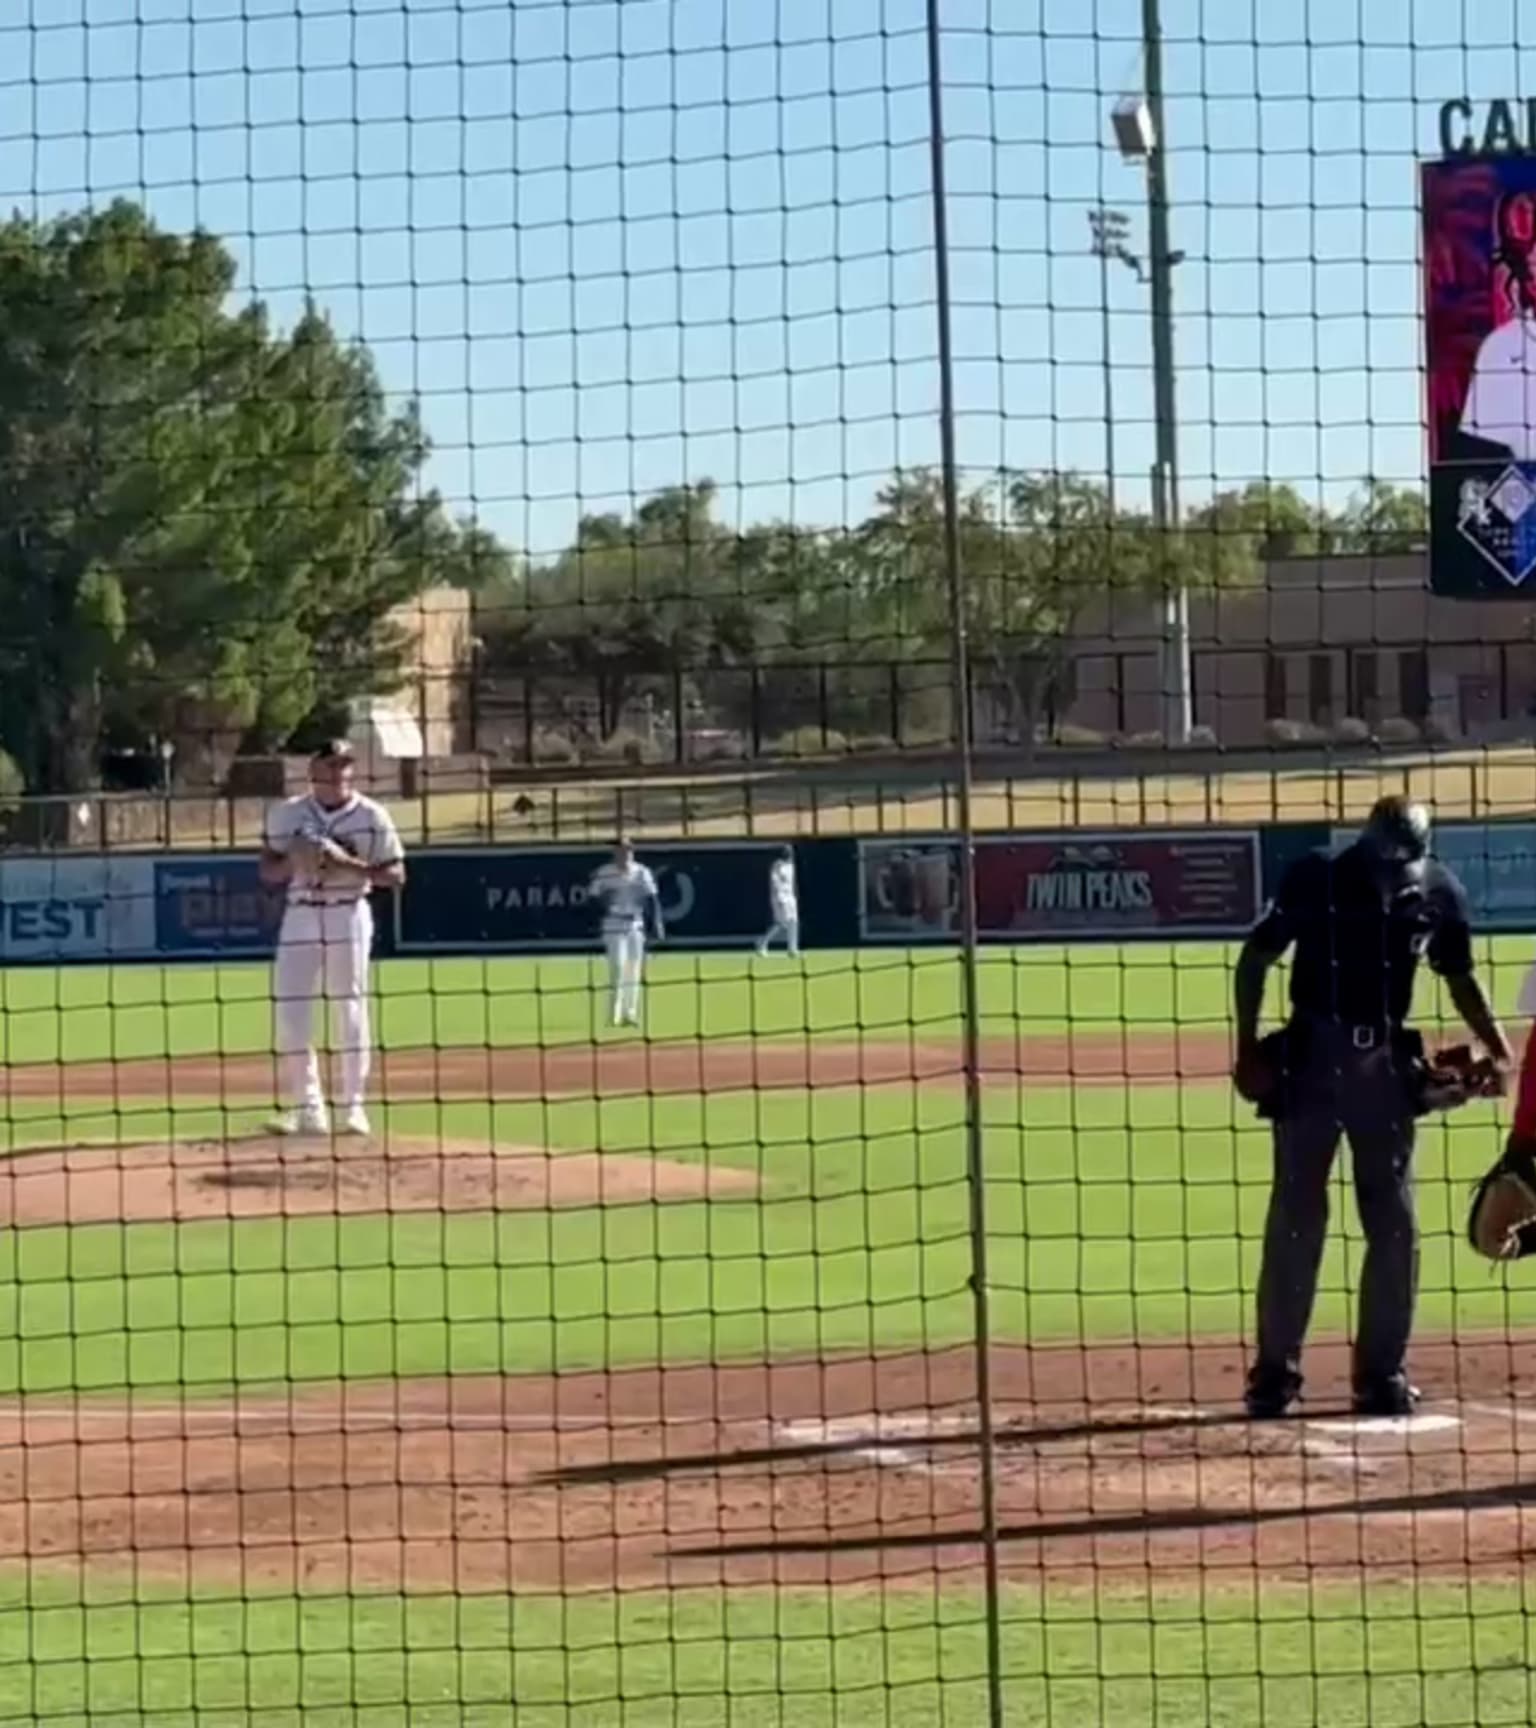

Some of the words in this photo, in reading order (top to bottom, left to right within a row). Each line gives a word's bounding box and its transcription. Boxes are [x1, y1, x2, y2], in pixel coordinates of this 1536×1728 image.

[487, 885, 591, 910] PARAD
[1027, 872, 1083, 910] TWIN
[1086, 870, 1152, 908] PEAKS
[0, 900, 103, 942] EST
